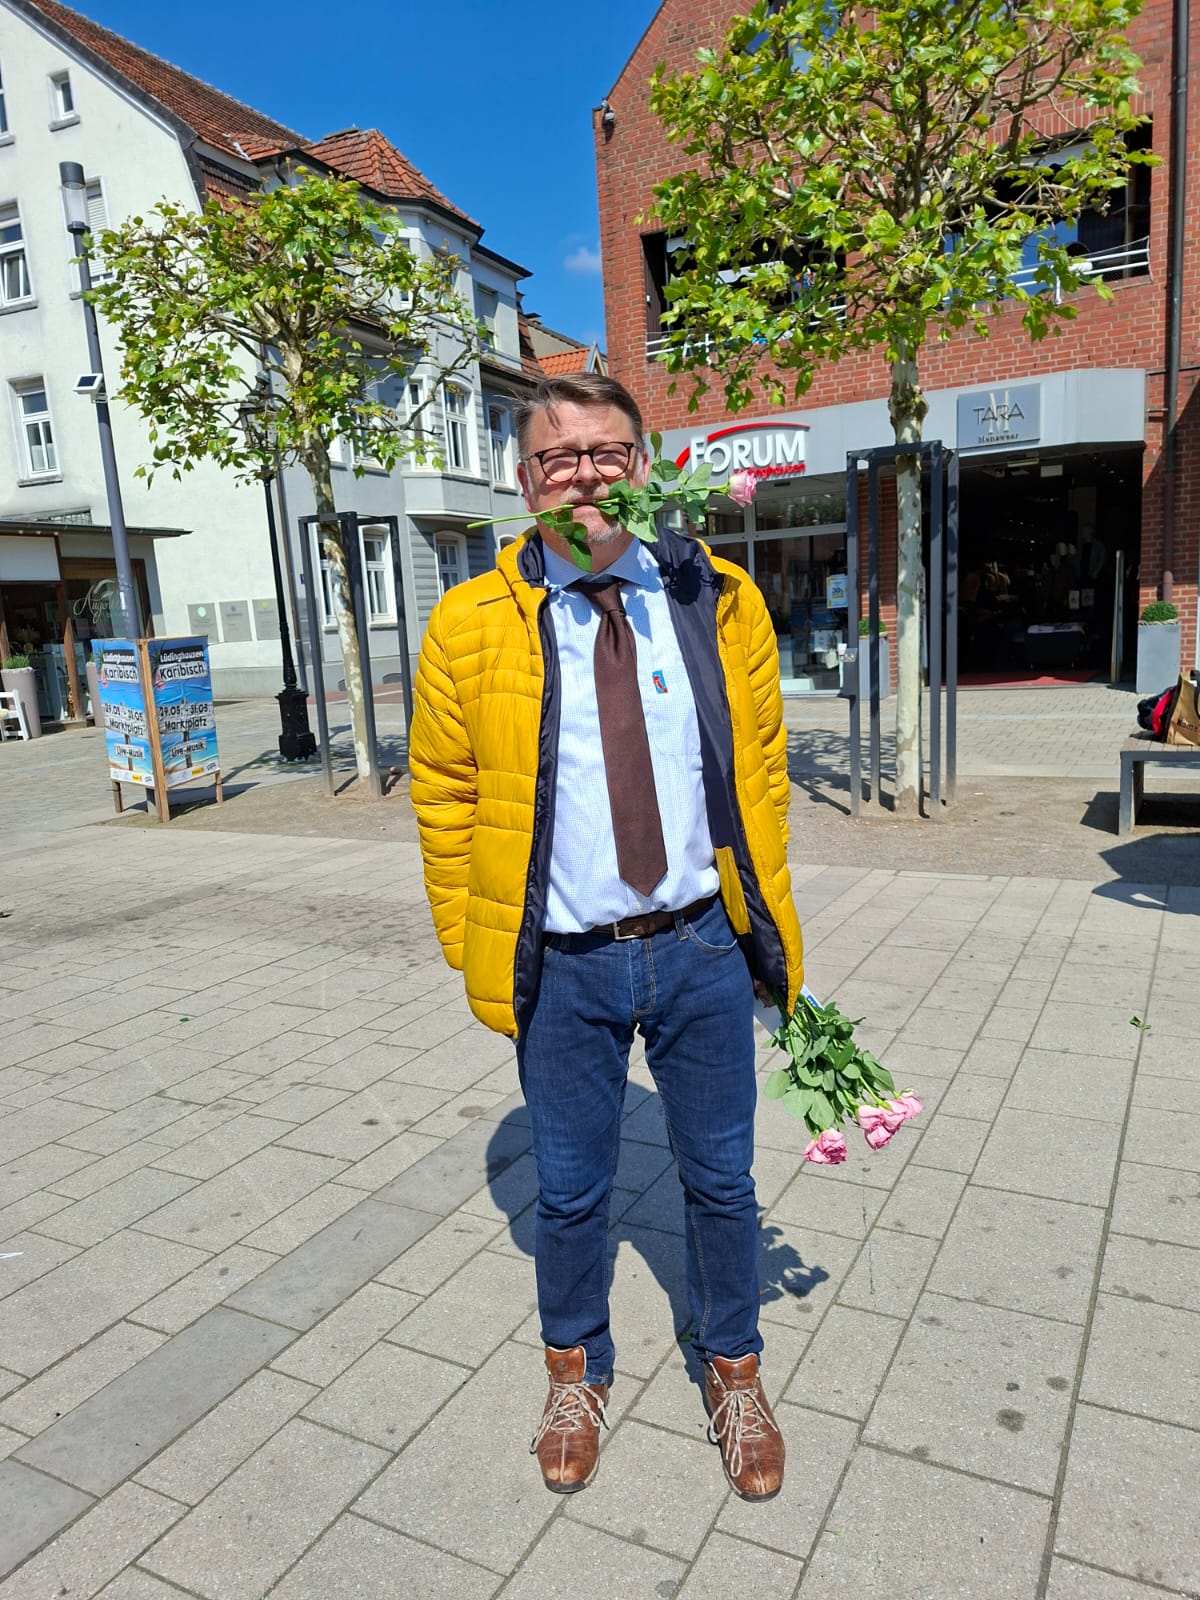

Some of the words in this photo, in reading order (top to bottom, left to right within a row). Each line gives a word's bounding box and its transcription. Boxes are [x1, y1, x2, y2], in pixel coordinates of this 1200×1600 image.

[973, 403, 1025, 424] TARA
[690, 430, 806, 474] FORUM
[160, 650, 204, 663] Lüdinghausen
[103, 667, 138, 680] Karibisch
[160, 663, 205, 680] Karibisch
[109, 718, 144, 736] Marktplatz
[164, 717, 207, 731] Marktplatz
[171, 742, 204, 758] Live-Musik
